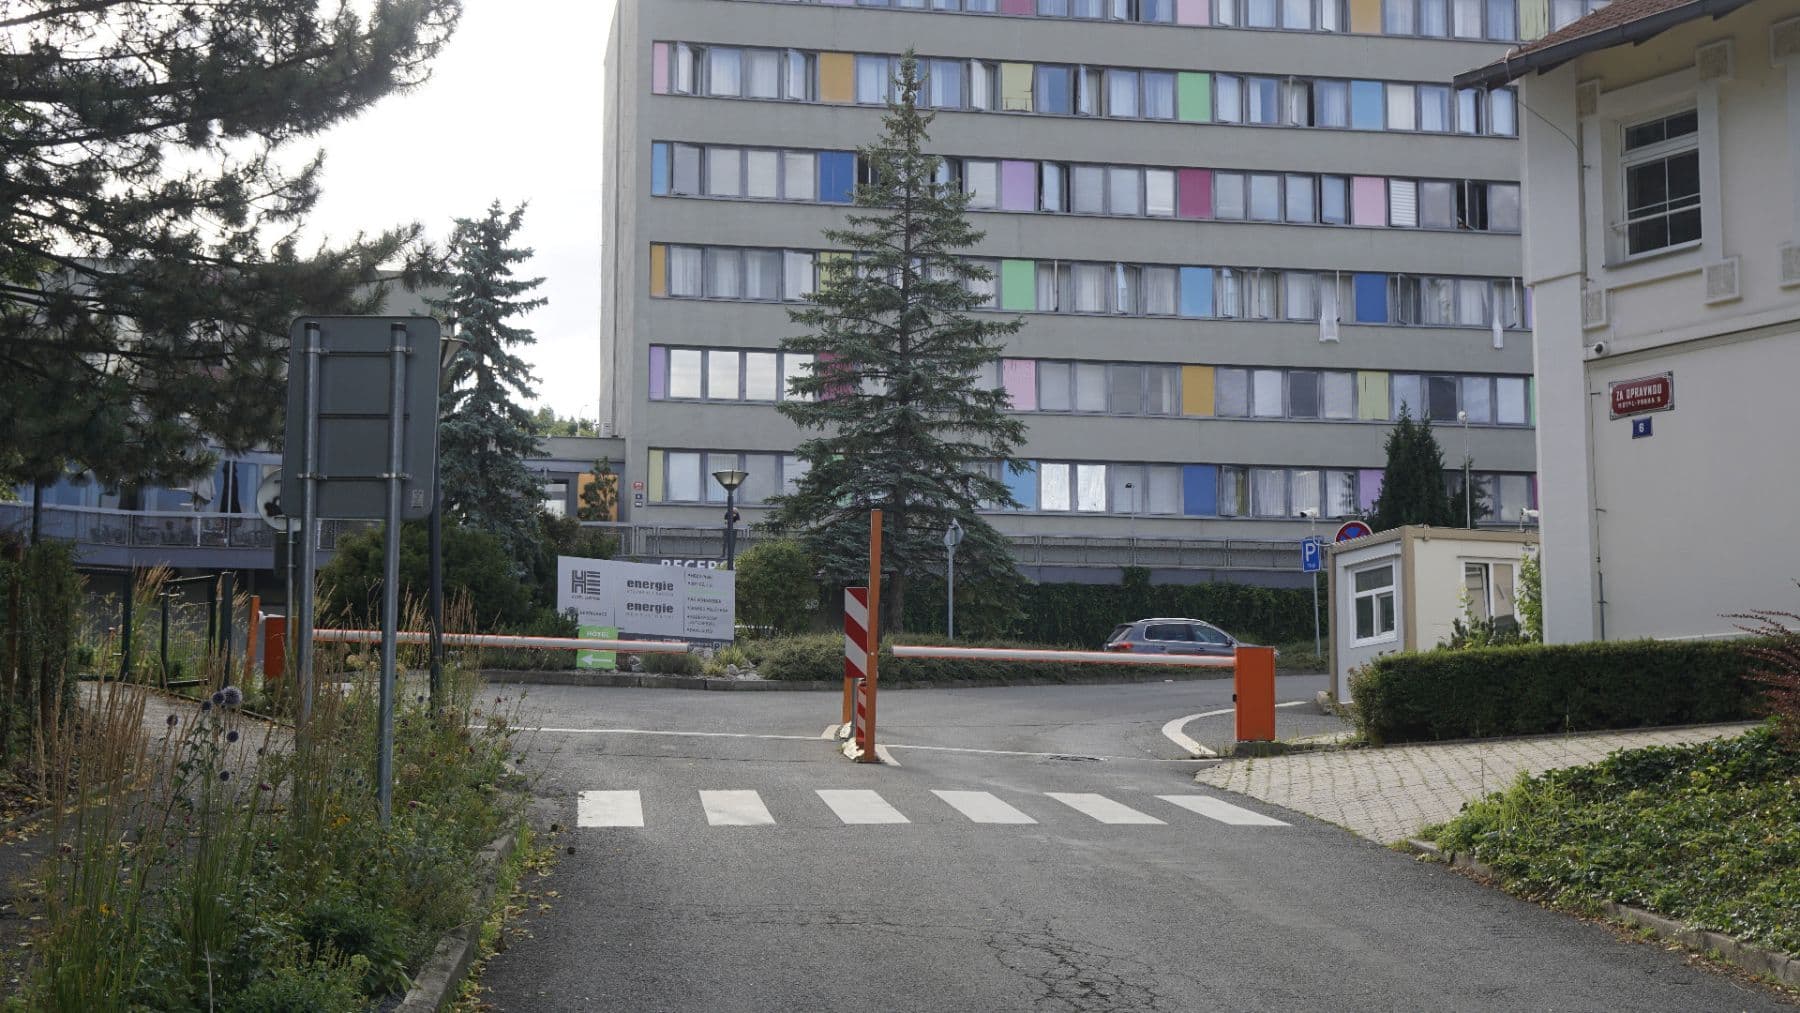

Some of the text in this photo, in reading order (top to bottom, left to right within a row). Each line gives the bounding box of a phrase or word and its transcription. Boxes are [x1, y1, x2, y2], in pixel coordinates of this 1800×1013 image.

[1616, 390, 1624, 401] ZA
[1639, 423, 1644, 432] 6
[1306, 543, 1316, 562] P
[626, 579, 674, 591] energie
[626, 602, 674, 614] energie
